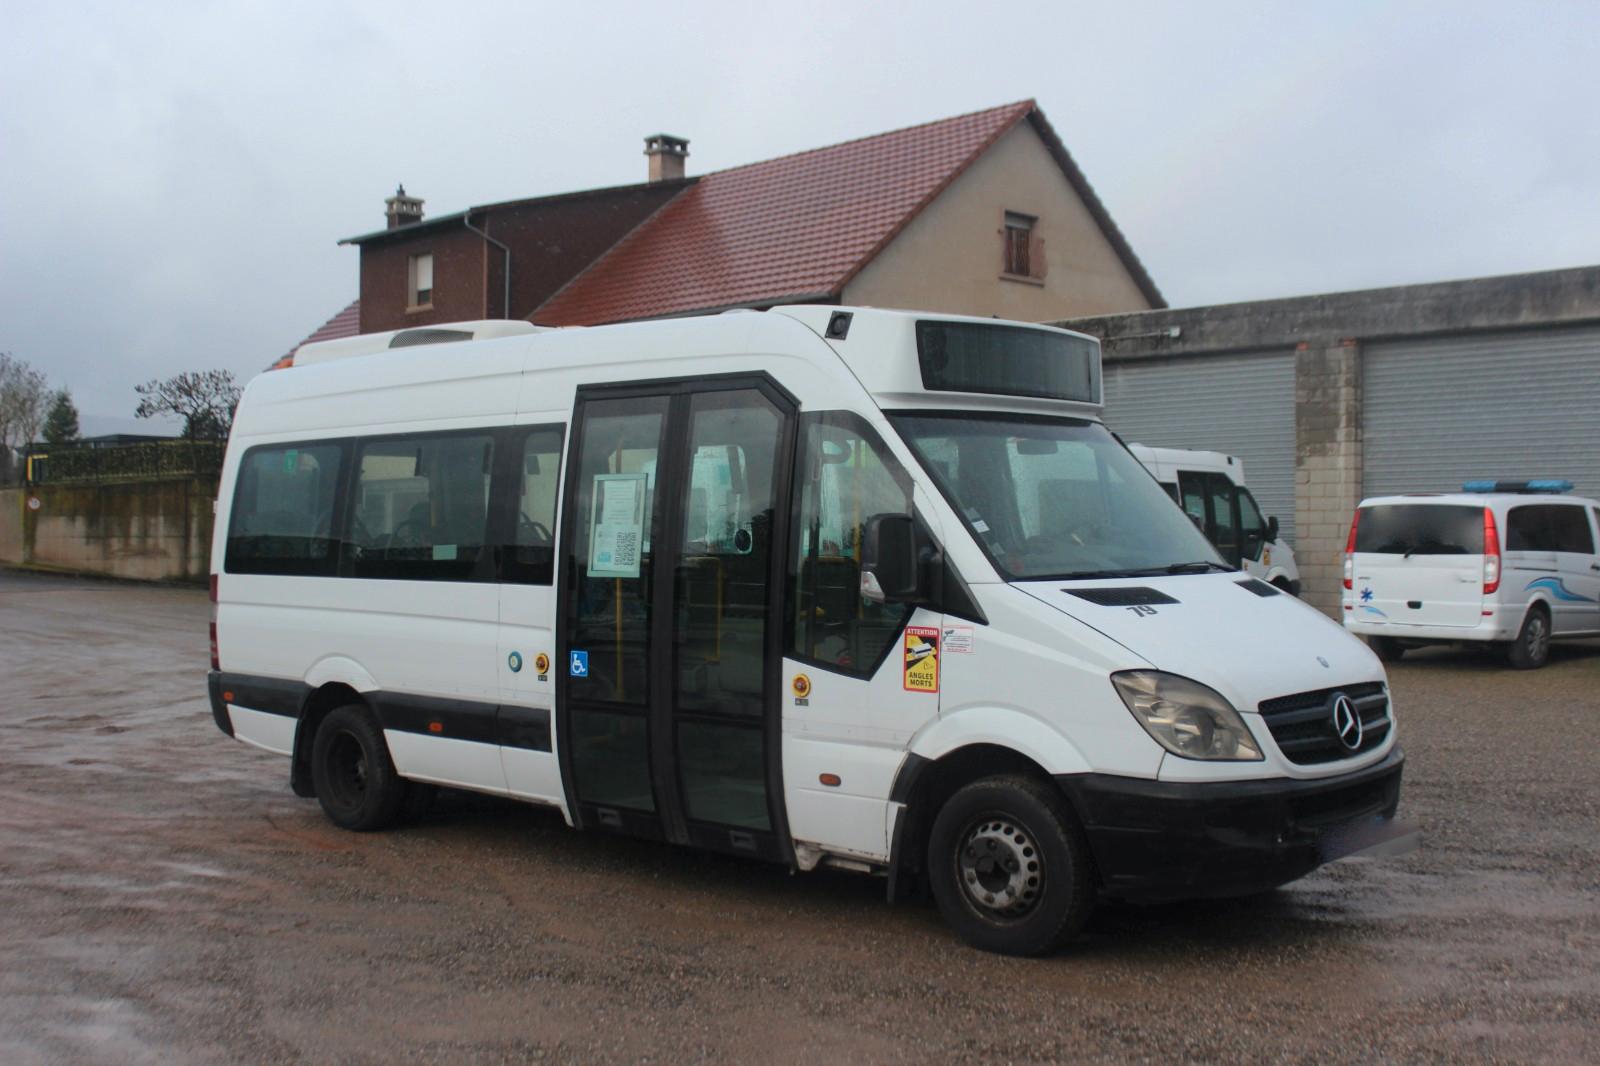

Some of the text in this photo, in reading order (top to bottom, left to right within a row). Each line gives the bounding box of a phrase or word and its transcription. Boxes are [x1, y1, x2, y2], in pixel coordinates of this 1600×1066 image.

[1125, 605, 1158, 617] 79
[907, 628, 938, 636] ATTENTION
[909, 672, 934, 680] ANGLES
[910, 679, 932, 687] MORTS
